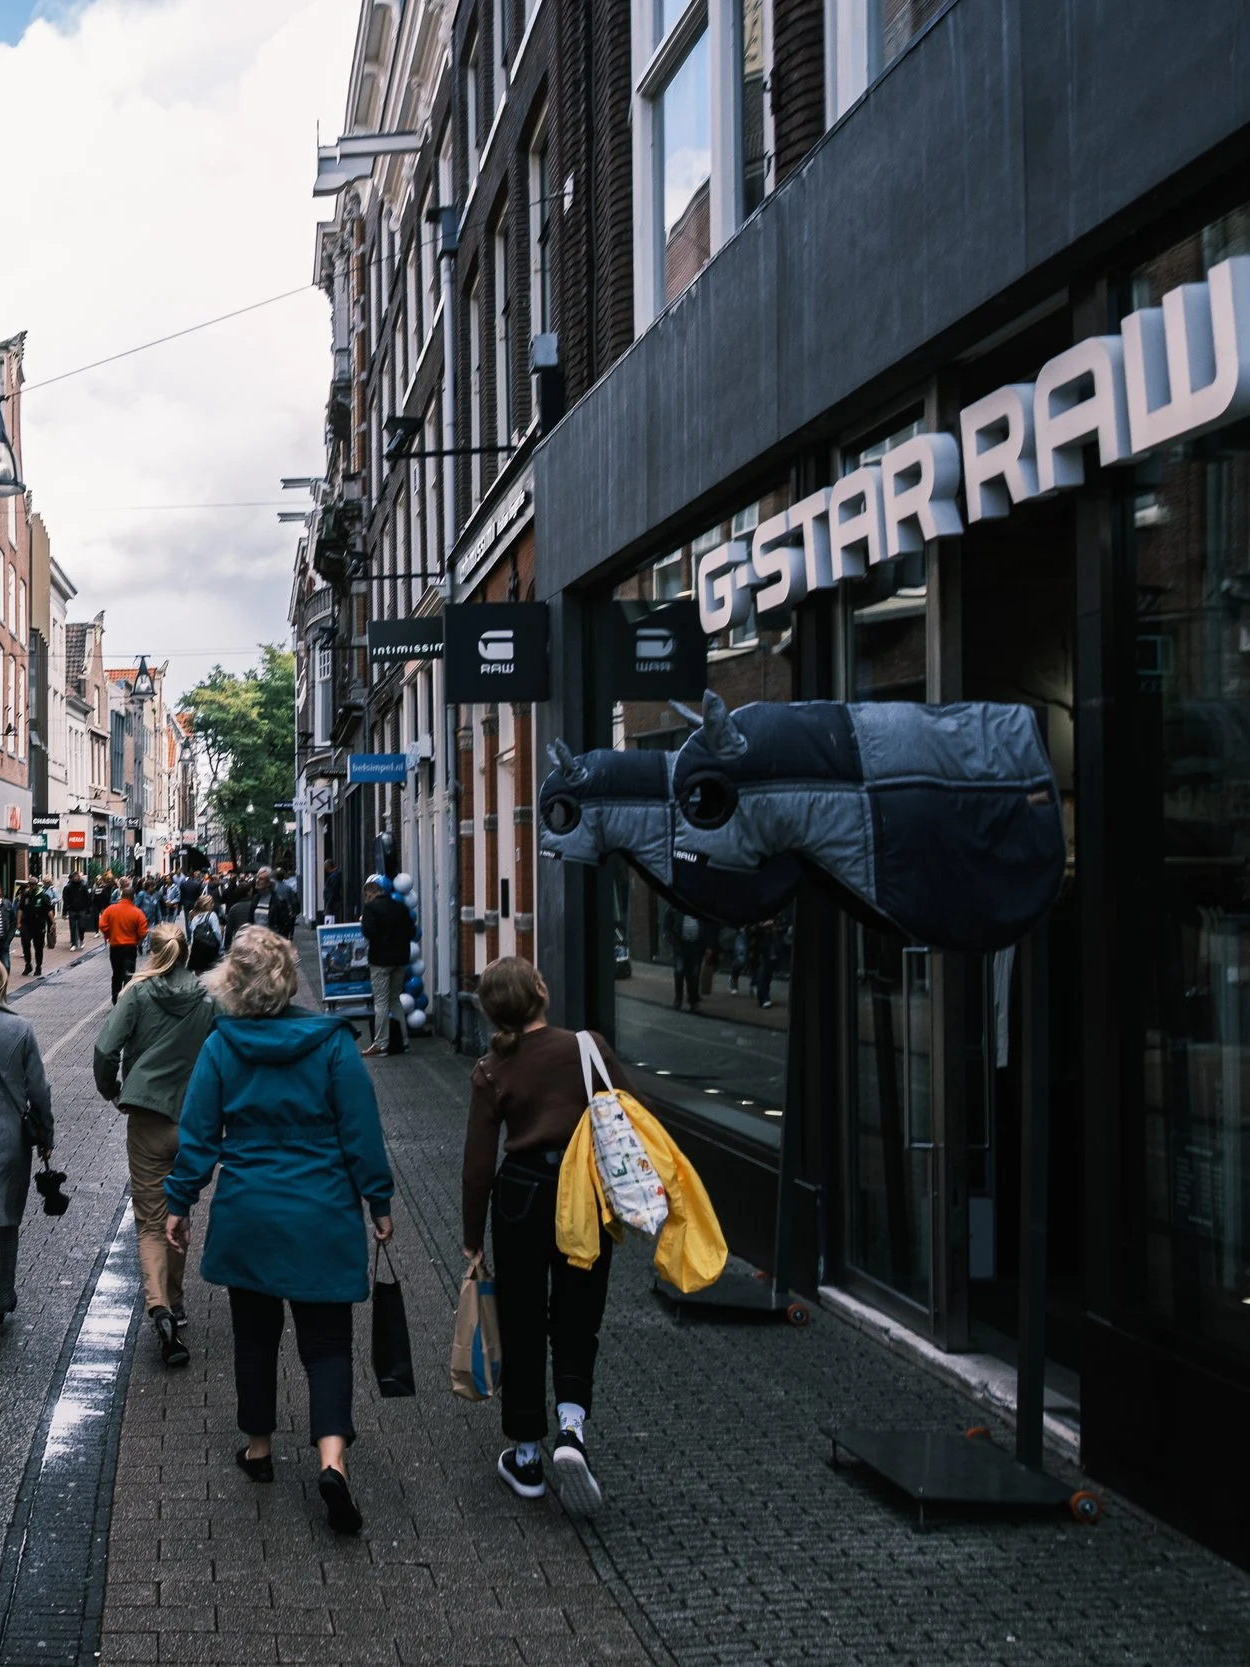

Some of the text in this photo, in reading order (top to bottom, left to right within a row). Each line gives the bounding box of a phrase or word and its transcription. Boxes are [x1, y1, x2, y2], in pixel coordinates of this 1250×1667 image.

[698, 256, 1250, 634] G-STAR RAW
[372, 642, 445, 656] intimissim
[480, 663, 515, 675] RAW
